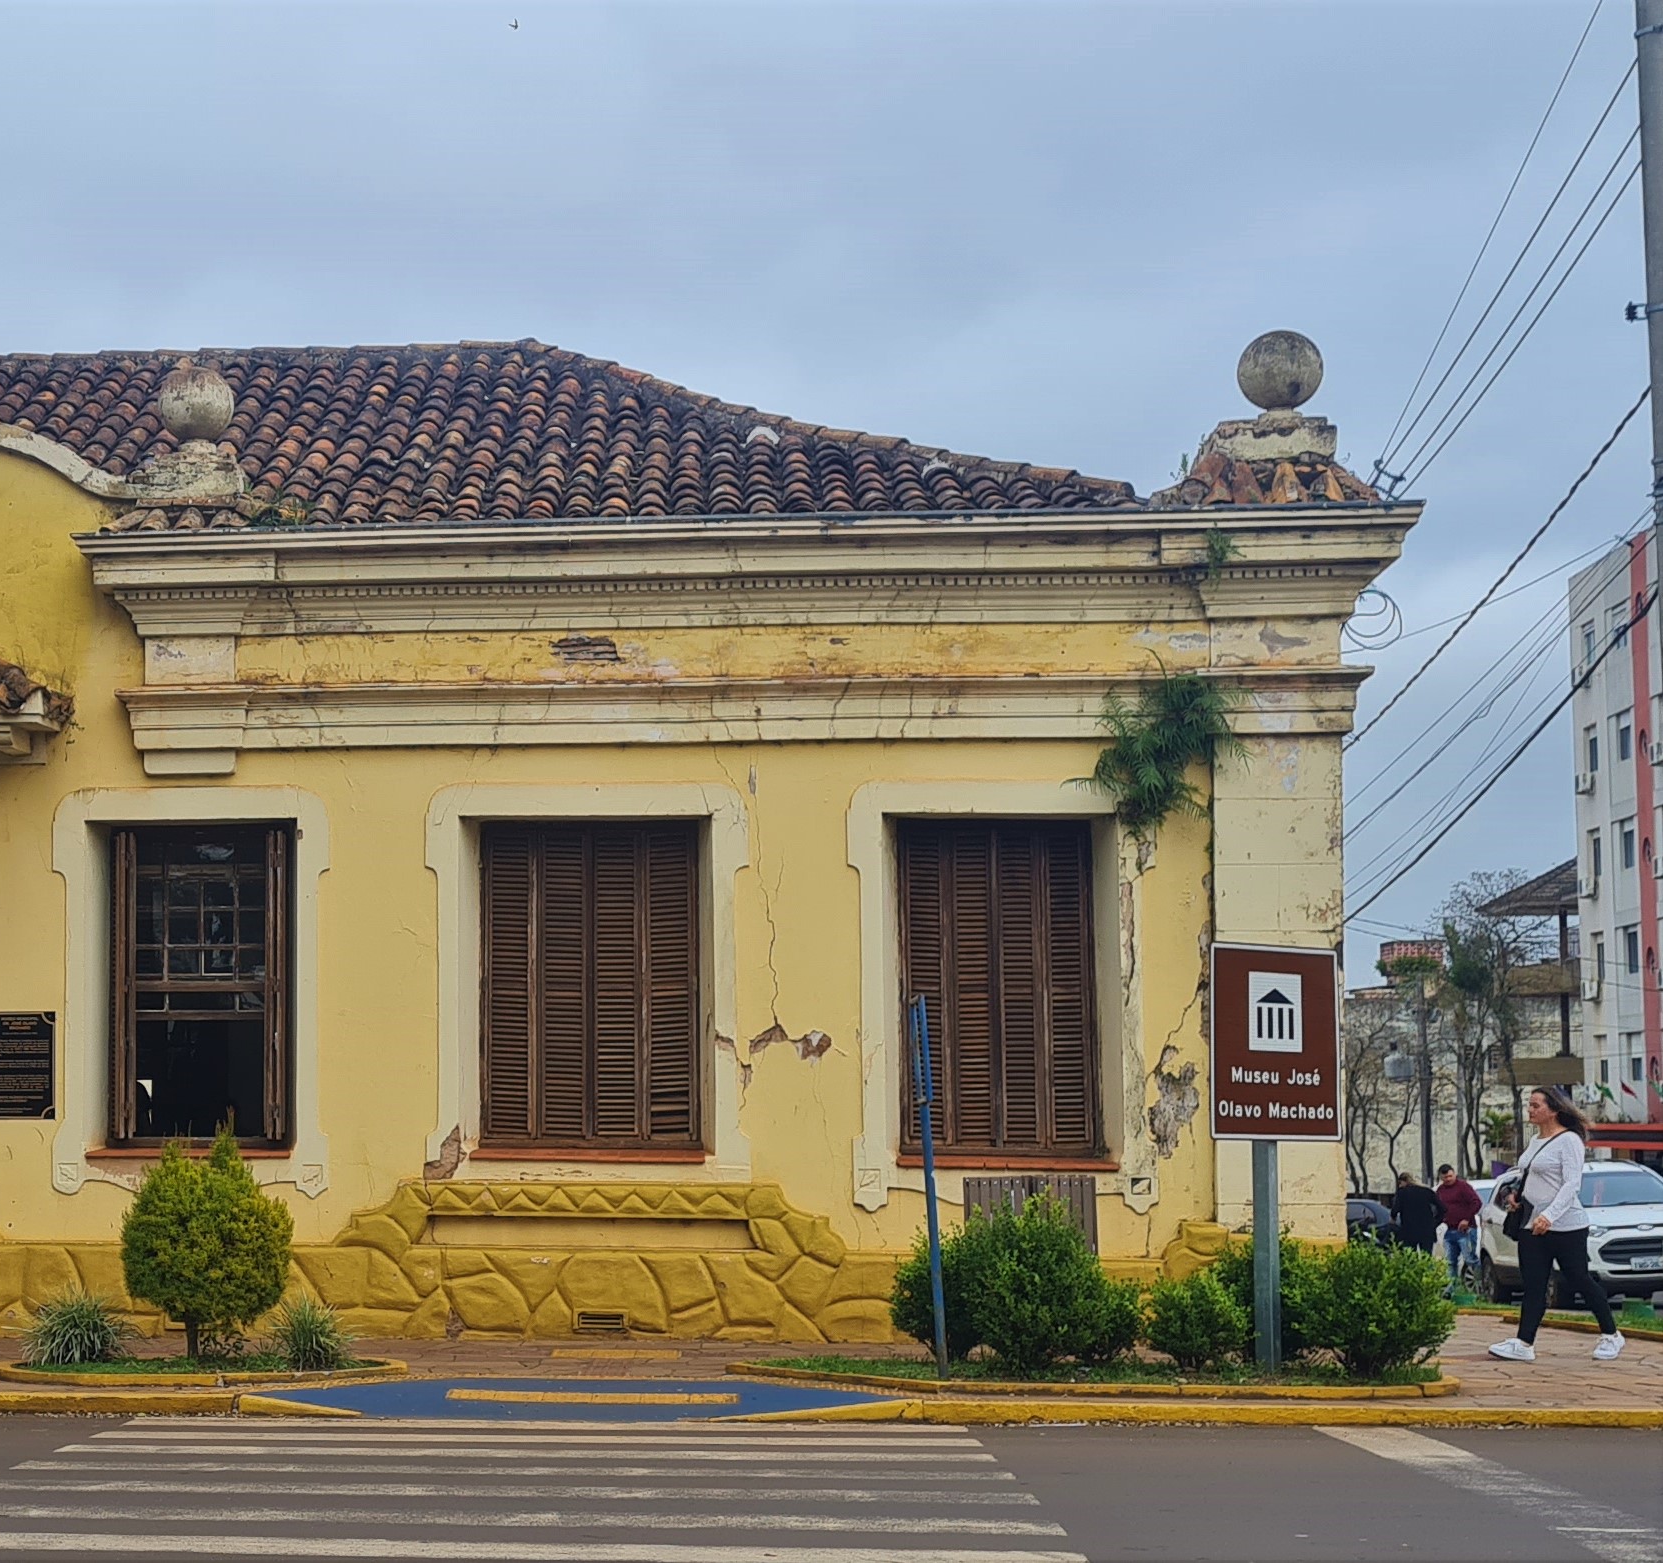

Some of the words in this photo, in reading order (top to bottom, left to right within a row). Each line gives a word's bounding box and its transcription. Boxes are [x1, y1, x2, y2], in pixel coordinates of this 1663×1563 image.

[1231, 1066, 1279, 1084] Museu
[1286, 1068, 1321, 1086] José
[1218, 1100, 1261, 1117] Olavo
[1268, 1102, 1334, 1119] Machado
